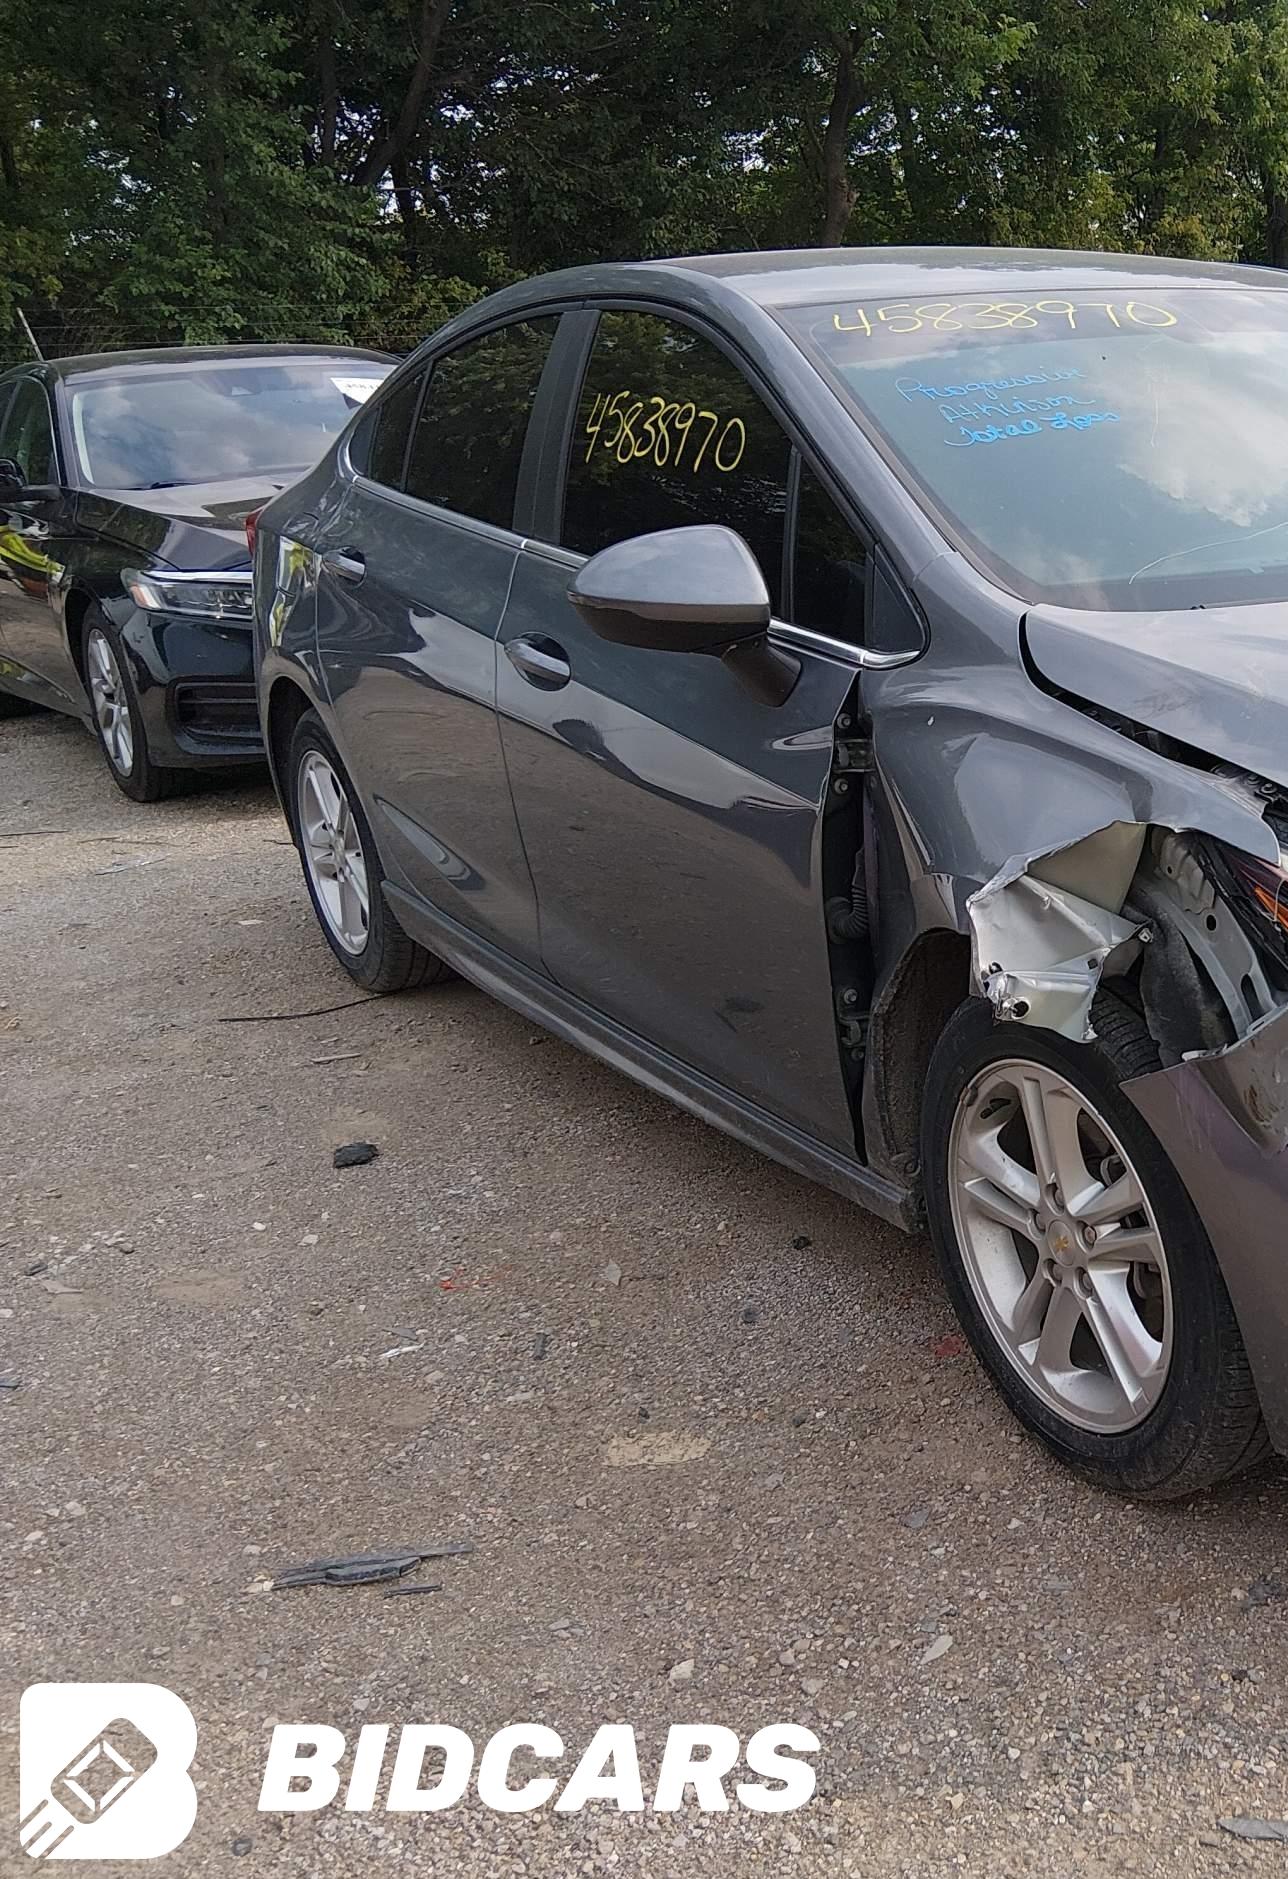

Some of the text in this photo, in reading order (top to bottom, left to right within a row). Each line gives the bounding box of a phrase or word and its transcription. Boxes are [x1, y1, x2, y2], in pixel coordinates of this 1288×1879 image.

[833, 300, 1178, 337] 45838970
[895, 366, 1087, 402] Progressive
[585, 390, 746, 473] 45838970
